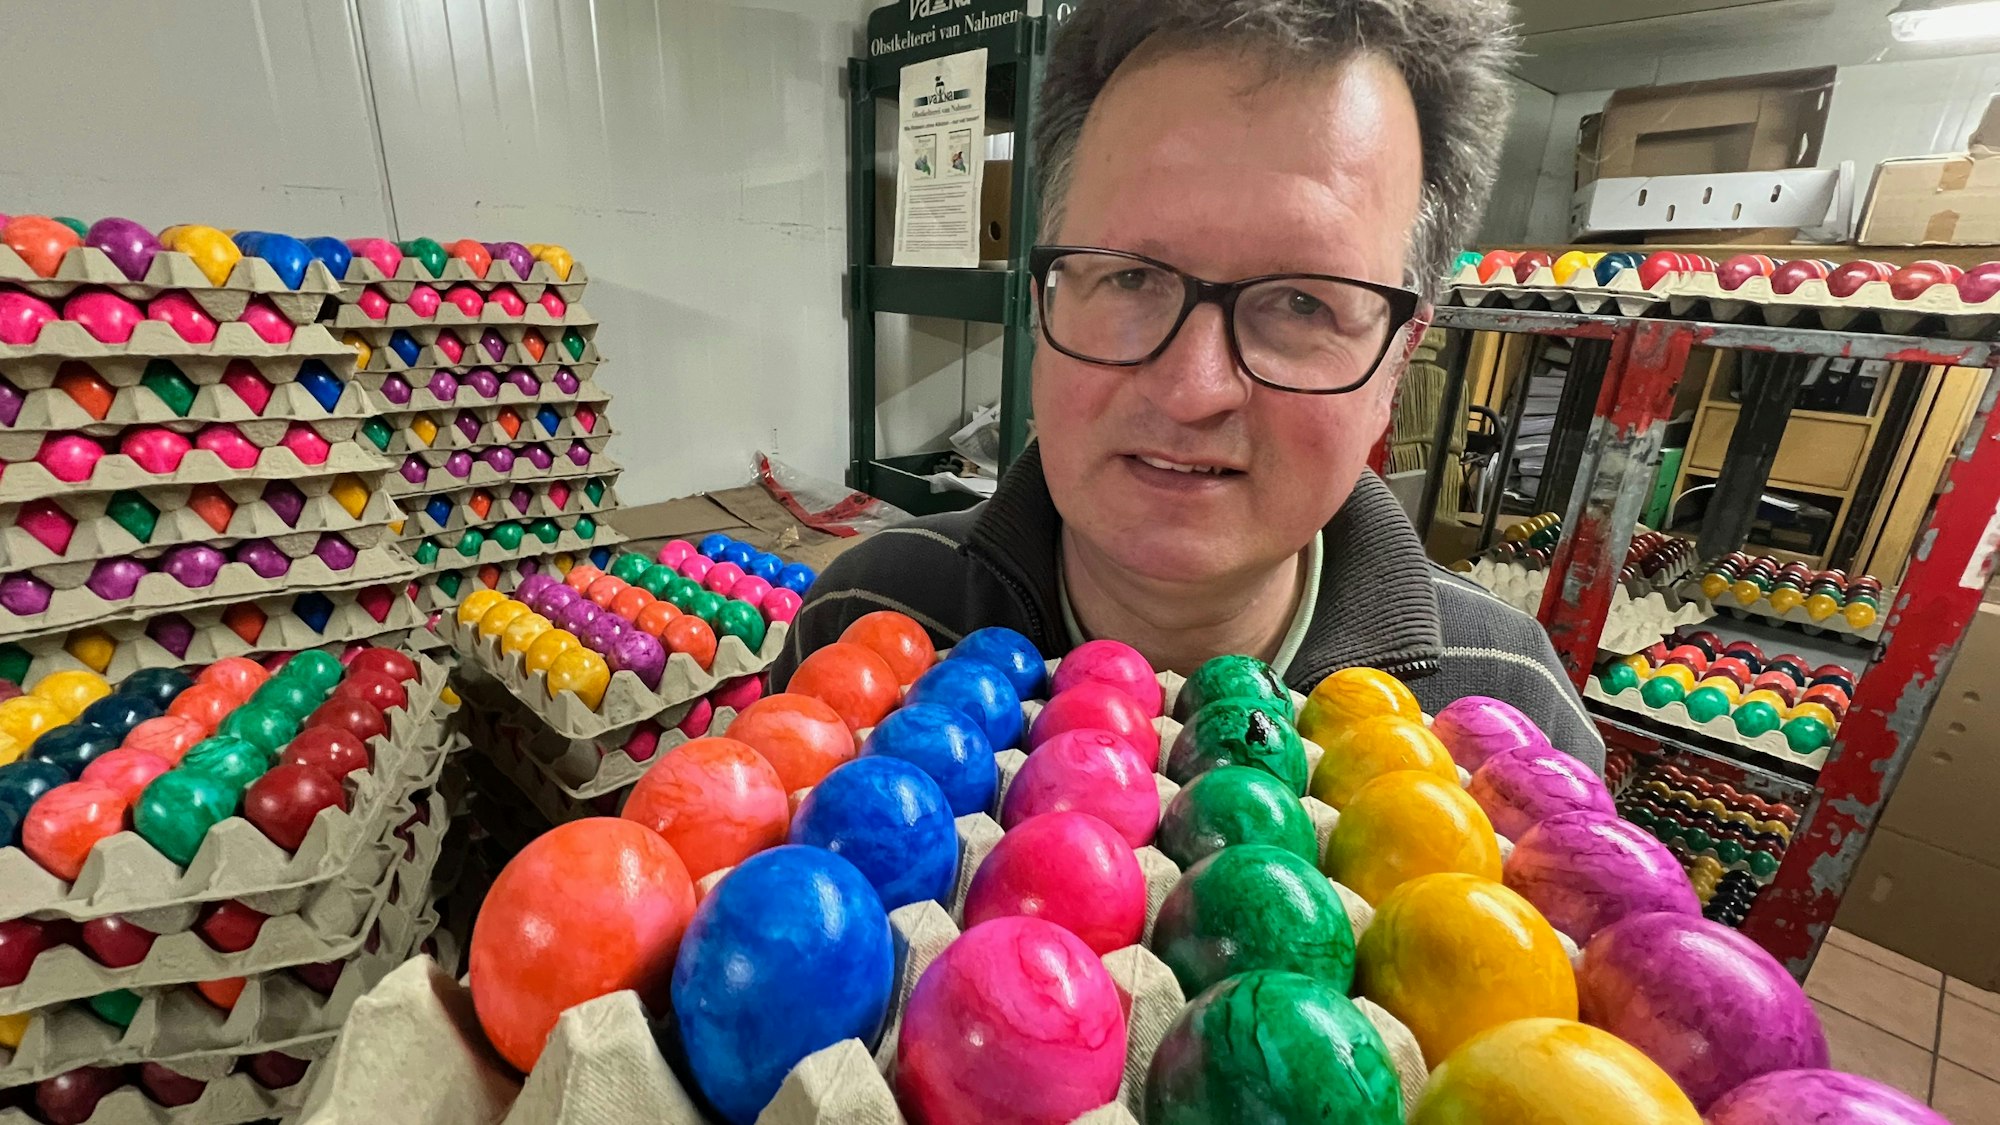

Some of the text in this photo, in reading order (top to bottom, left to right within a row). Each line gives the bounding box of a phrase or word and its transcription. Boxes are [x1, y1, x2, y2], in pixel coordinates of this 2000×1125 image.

[870, 9, 1018, 57] Obstkelterei van Nahmen
